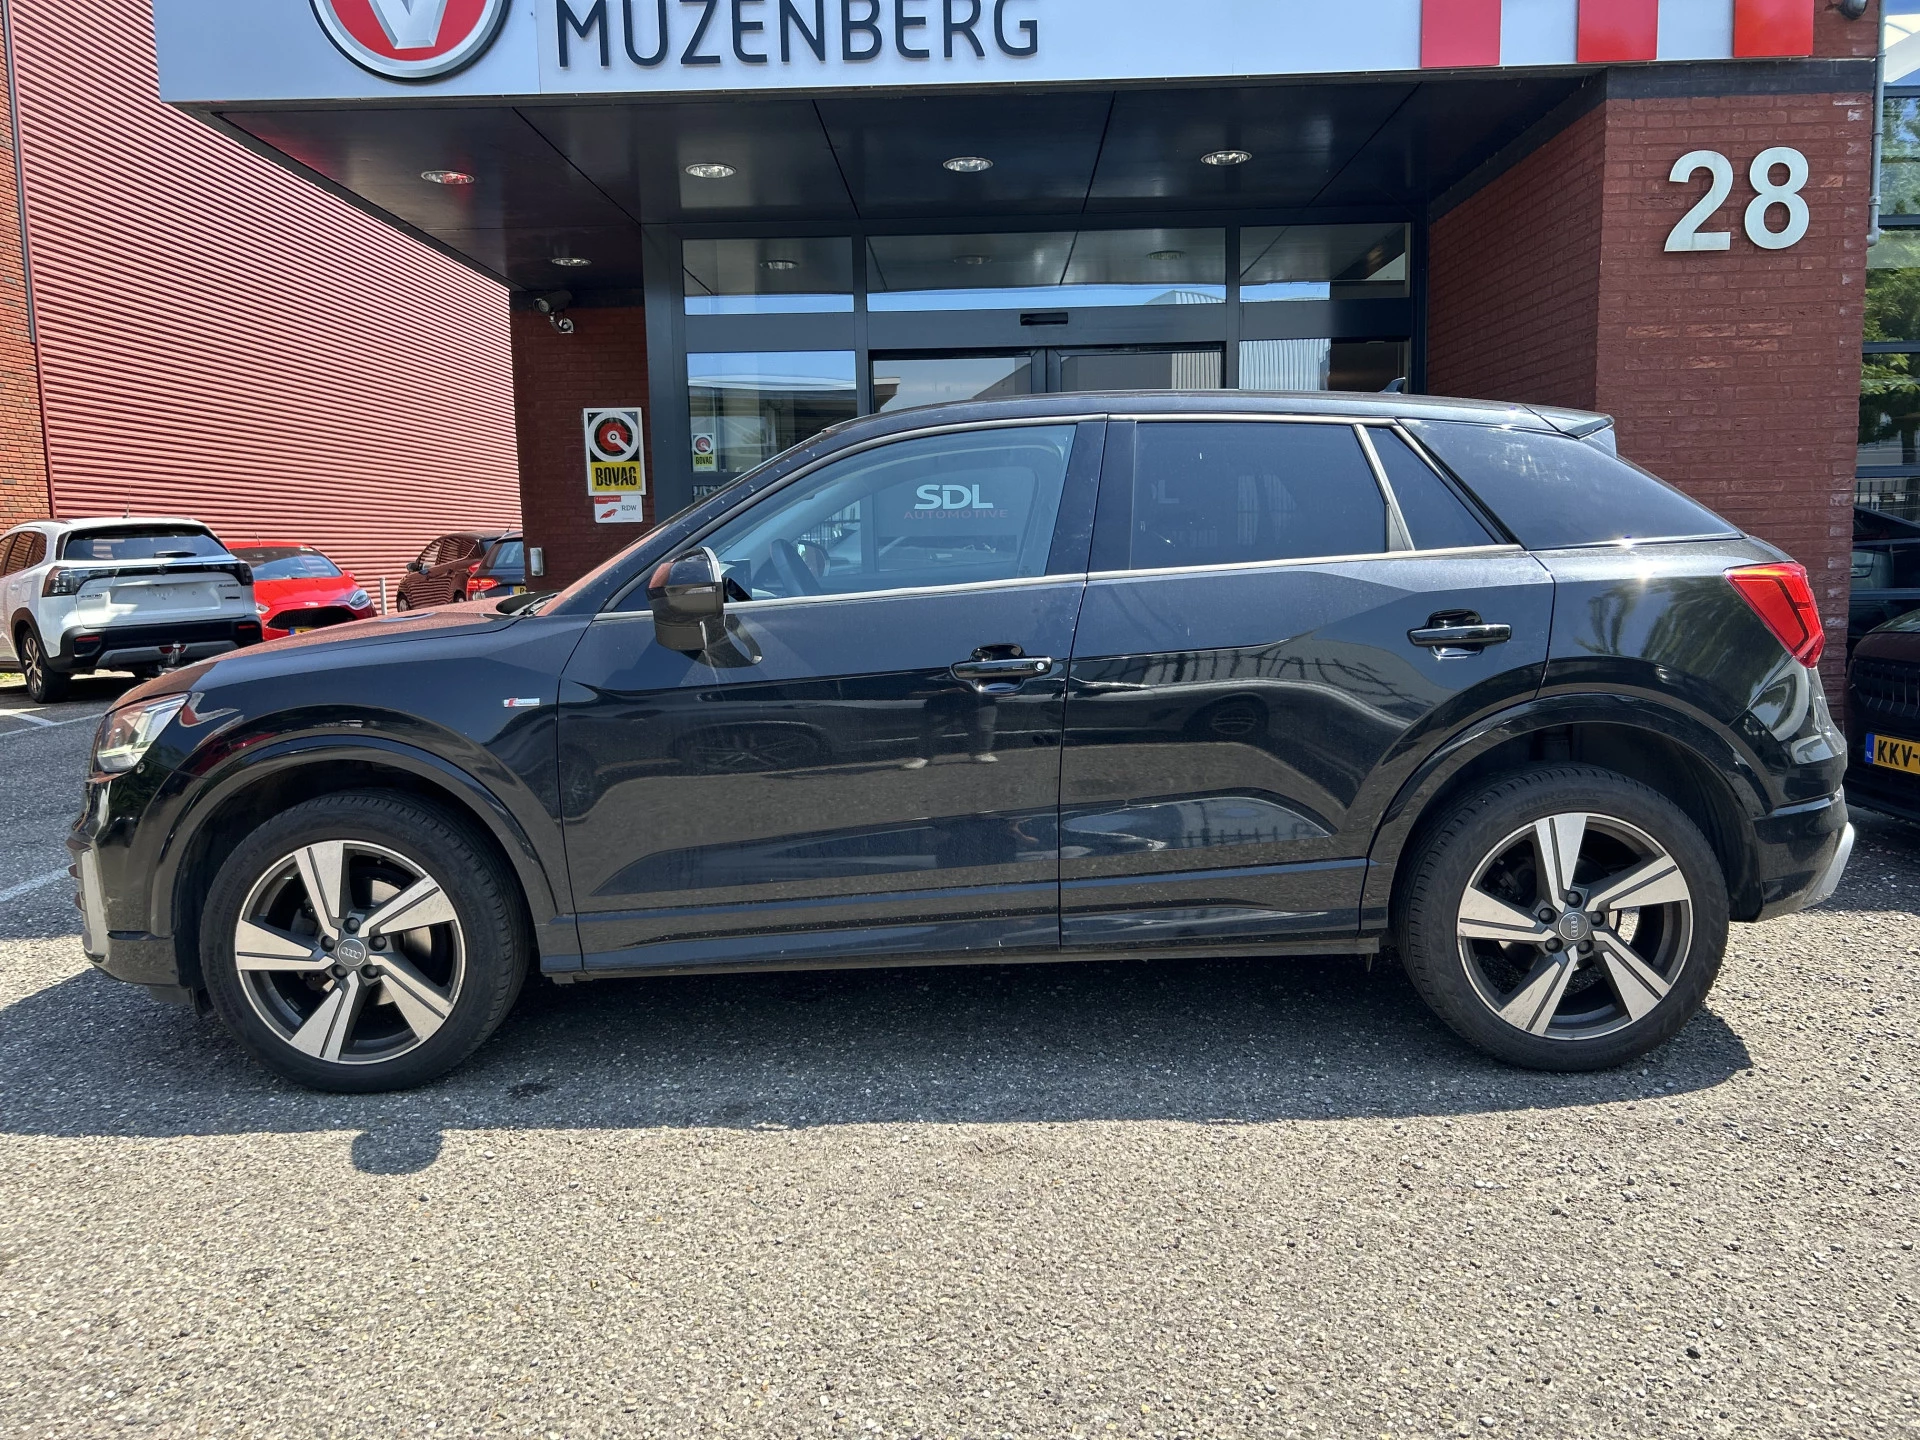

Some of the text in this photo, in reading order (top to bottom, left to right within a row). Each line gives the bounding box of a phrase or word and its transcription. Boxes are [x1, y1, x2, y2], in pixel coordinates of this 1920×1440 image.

[557, 0, 1038, 67] MUZENBERG
[1664, 147, 1809, 252] 28
[695, 456, 713, 465] BOVAG
[595, 466, 637, 487] BOVAG
[914, 484, 994, 509] SDL
[903, 509, 1009, 520] AUTOMOTIVE
[1877, 739, 1920, 767] KKV-
